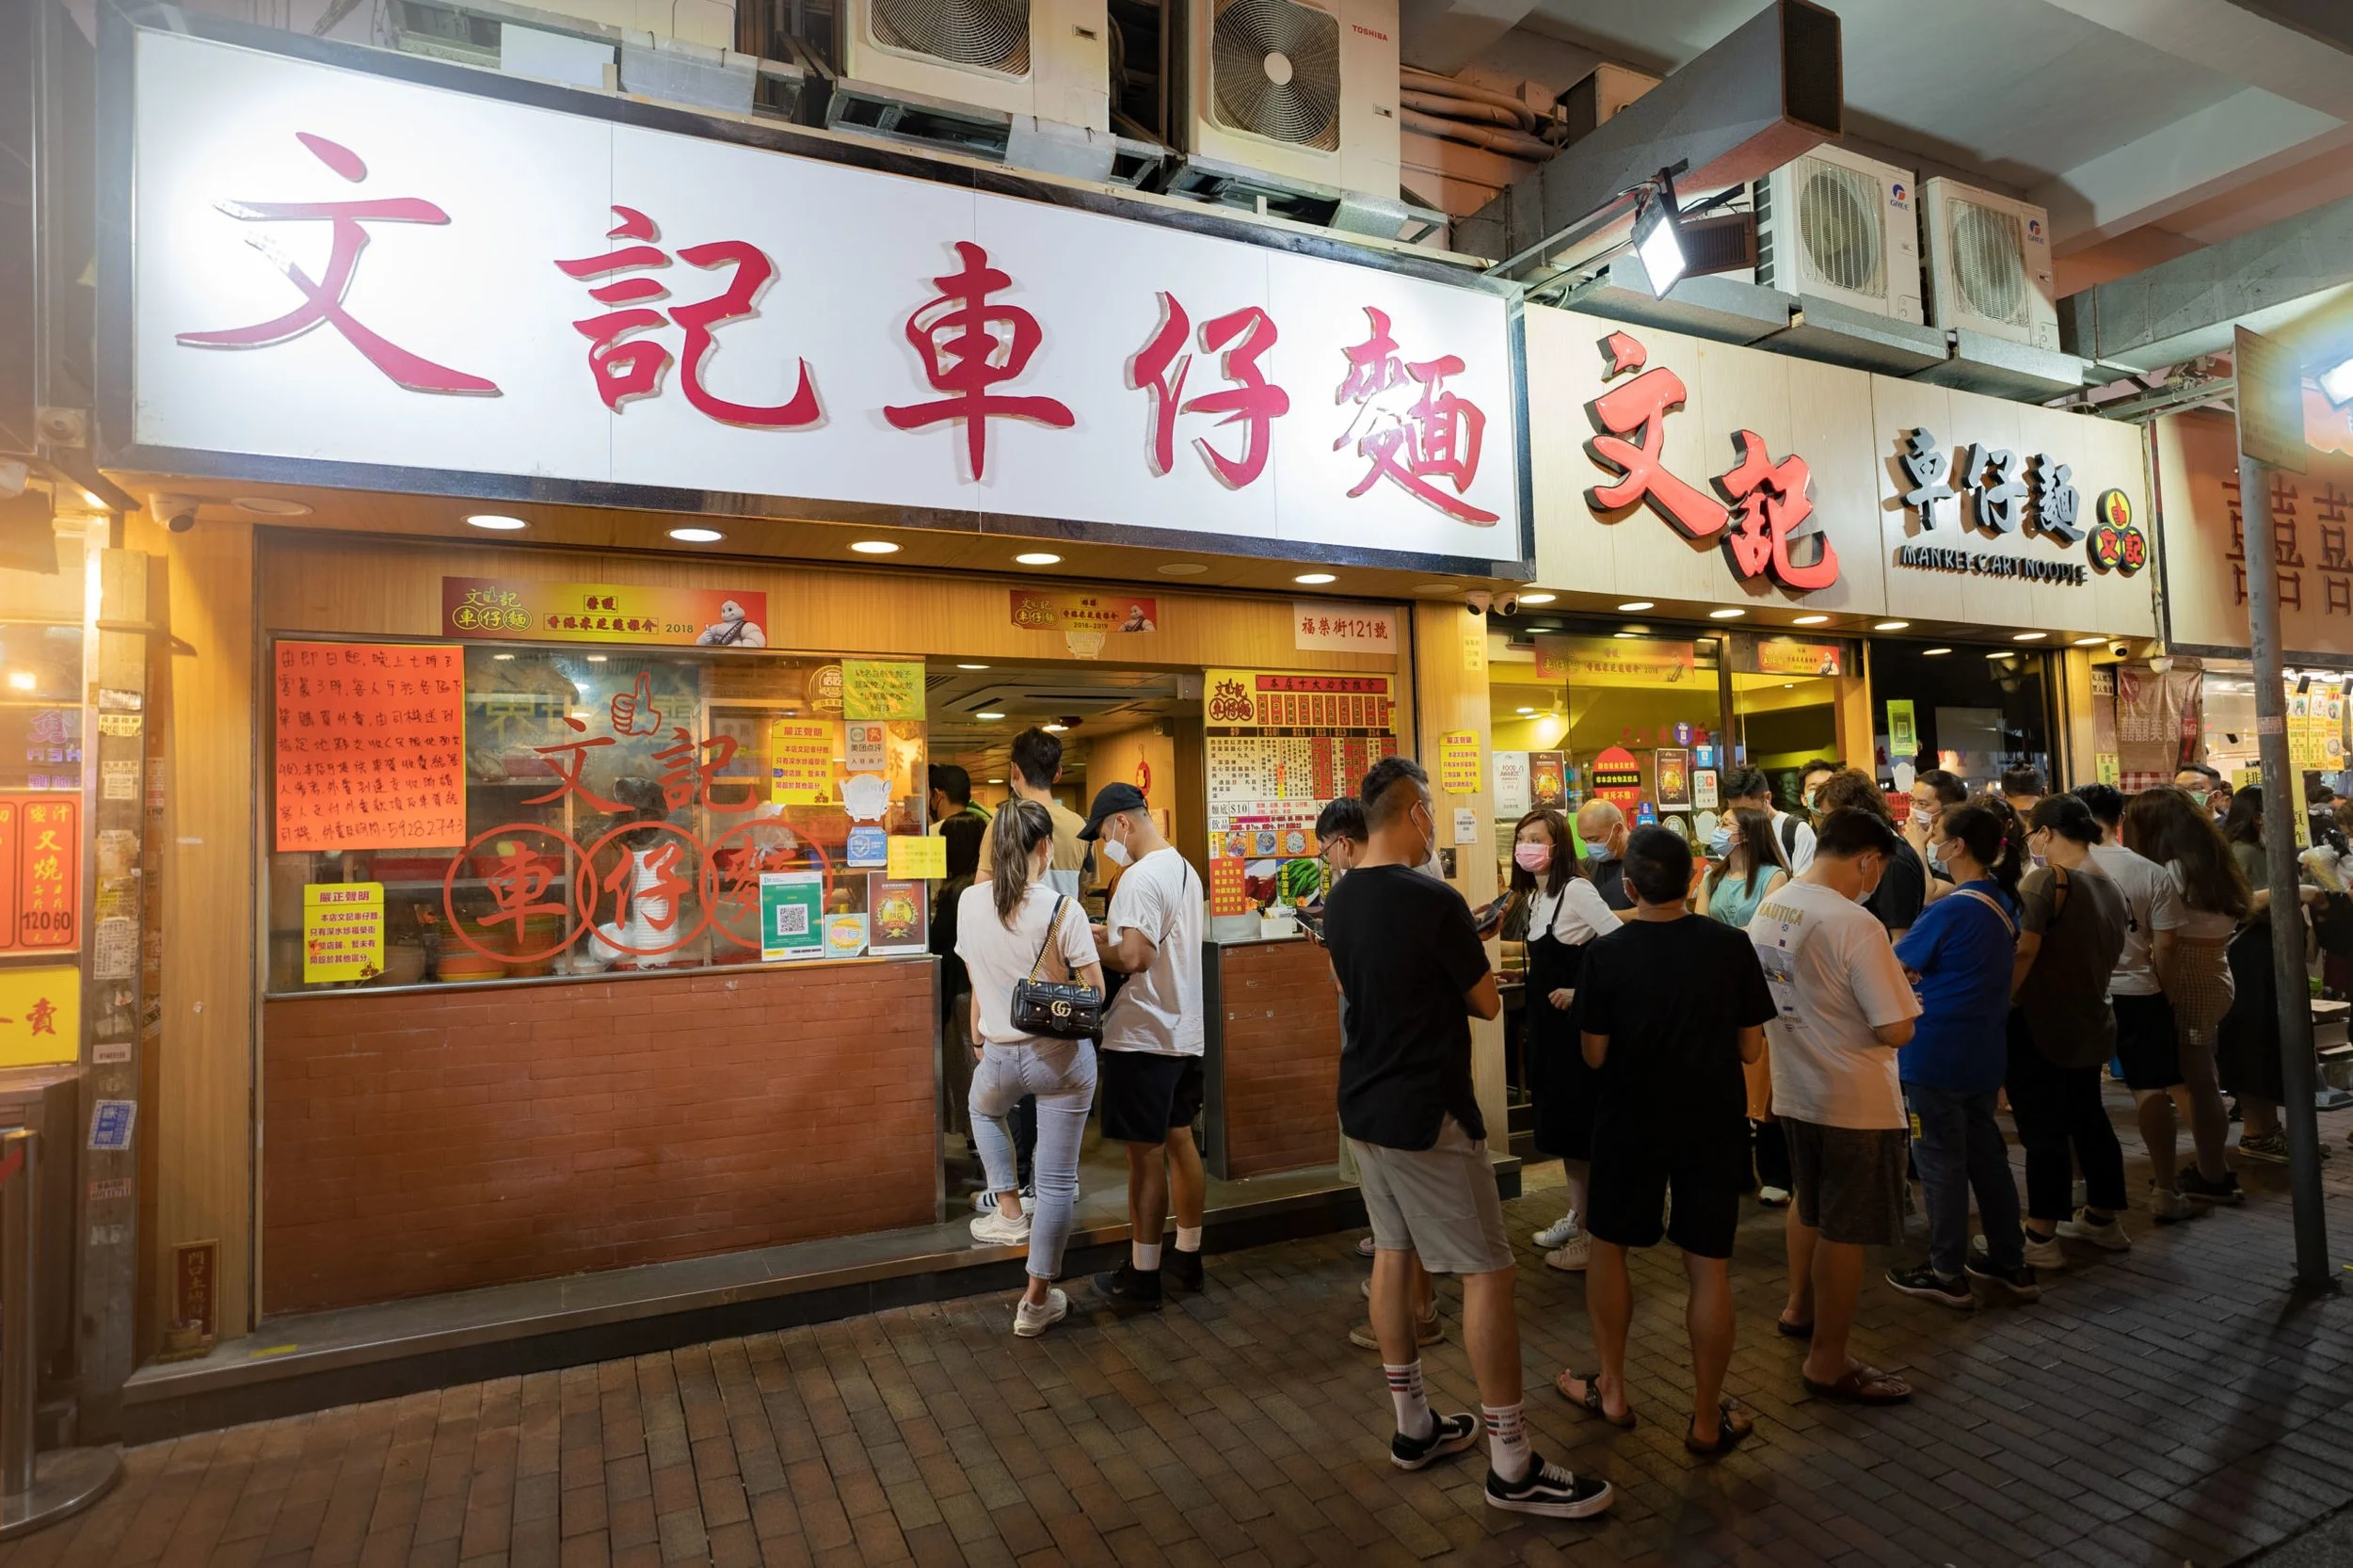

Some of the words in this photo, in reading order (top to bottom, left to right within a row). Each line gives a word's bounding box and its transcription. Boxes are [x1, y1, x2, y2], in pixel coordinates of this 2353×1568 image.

[1352, 24, 1388, 42] TOSHIBA
[1890, 199, 1910, 211] GREE
[2027, 234, 2045, 245] GREE
[175, 132, 1501, 528] 文記車仔麵
[1583, 330, 1839, 591] 文記
[1898, 427, 2087, 543] 車仔麵
[2099, 528, 2144, 565] 文記
[2025, 560, 2089, 584] NOODLE
[465, 587, 521, 609] 文記
[456, 609, 529, 632] 車仔麵
[665, 623, 694, 634] 2018
[1302, 616, 1388, 639] 福榮街121號
[521, 717, 759, 813] 文記
[1230, 804, 1248, 813] $10
[33, 829, 64, 881] 叉燒
[320, 890, 370, 903] 嚴正聲明
[22, 911, 52, 931] 120
[54, 910, 72, 930] 60
